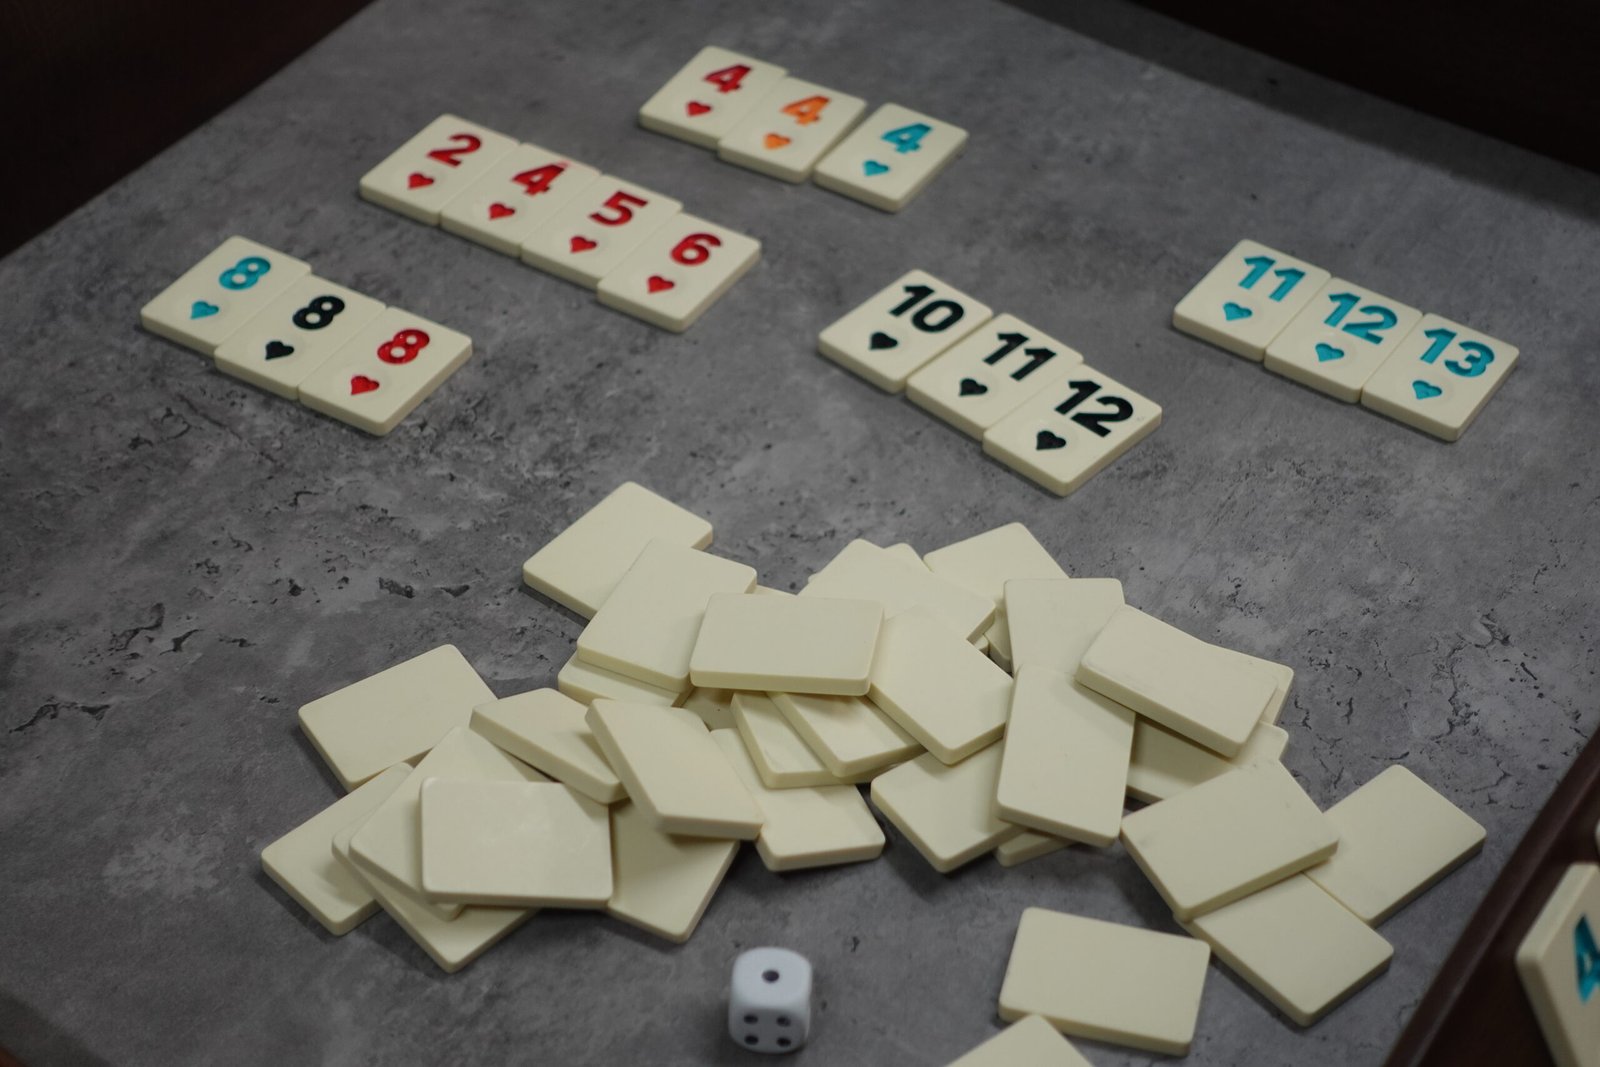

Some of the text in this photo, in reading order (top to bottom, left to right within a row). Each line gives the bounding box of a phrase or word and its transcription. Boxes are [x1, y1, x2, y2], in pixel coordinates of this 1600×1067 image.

[703, 64, 752, 94] 4
[780, 95, 830, 126] 4
[427, 133, 482, 168] 2
[882, 123, 932, 154] 4
[511, 163, 567, 196] 4
[589, 190, 648, 227] 5
[670, 232, 721, 267] 6
[219, 255, 271, 291] 8
[1239, 255, 1305, 303] 11
[292, 295, 345, 330] 8
[890, 284, 964, 333] 10
[1324, 292, 1398, 345] 12
[376, 328, 430, 366] 8
[984, 333, 1056, 381] 11
[1420, 328, 1495, 379] 13
[1055, 380, 1134, 438] 12
